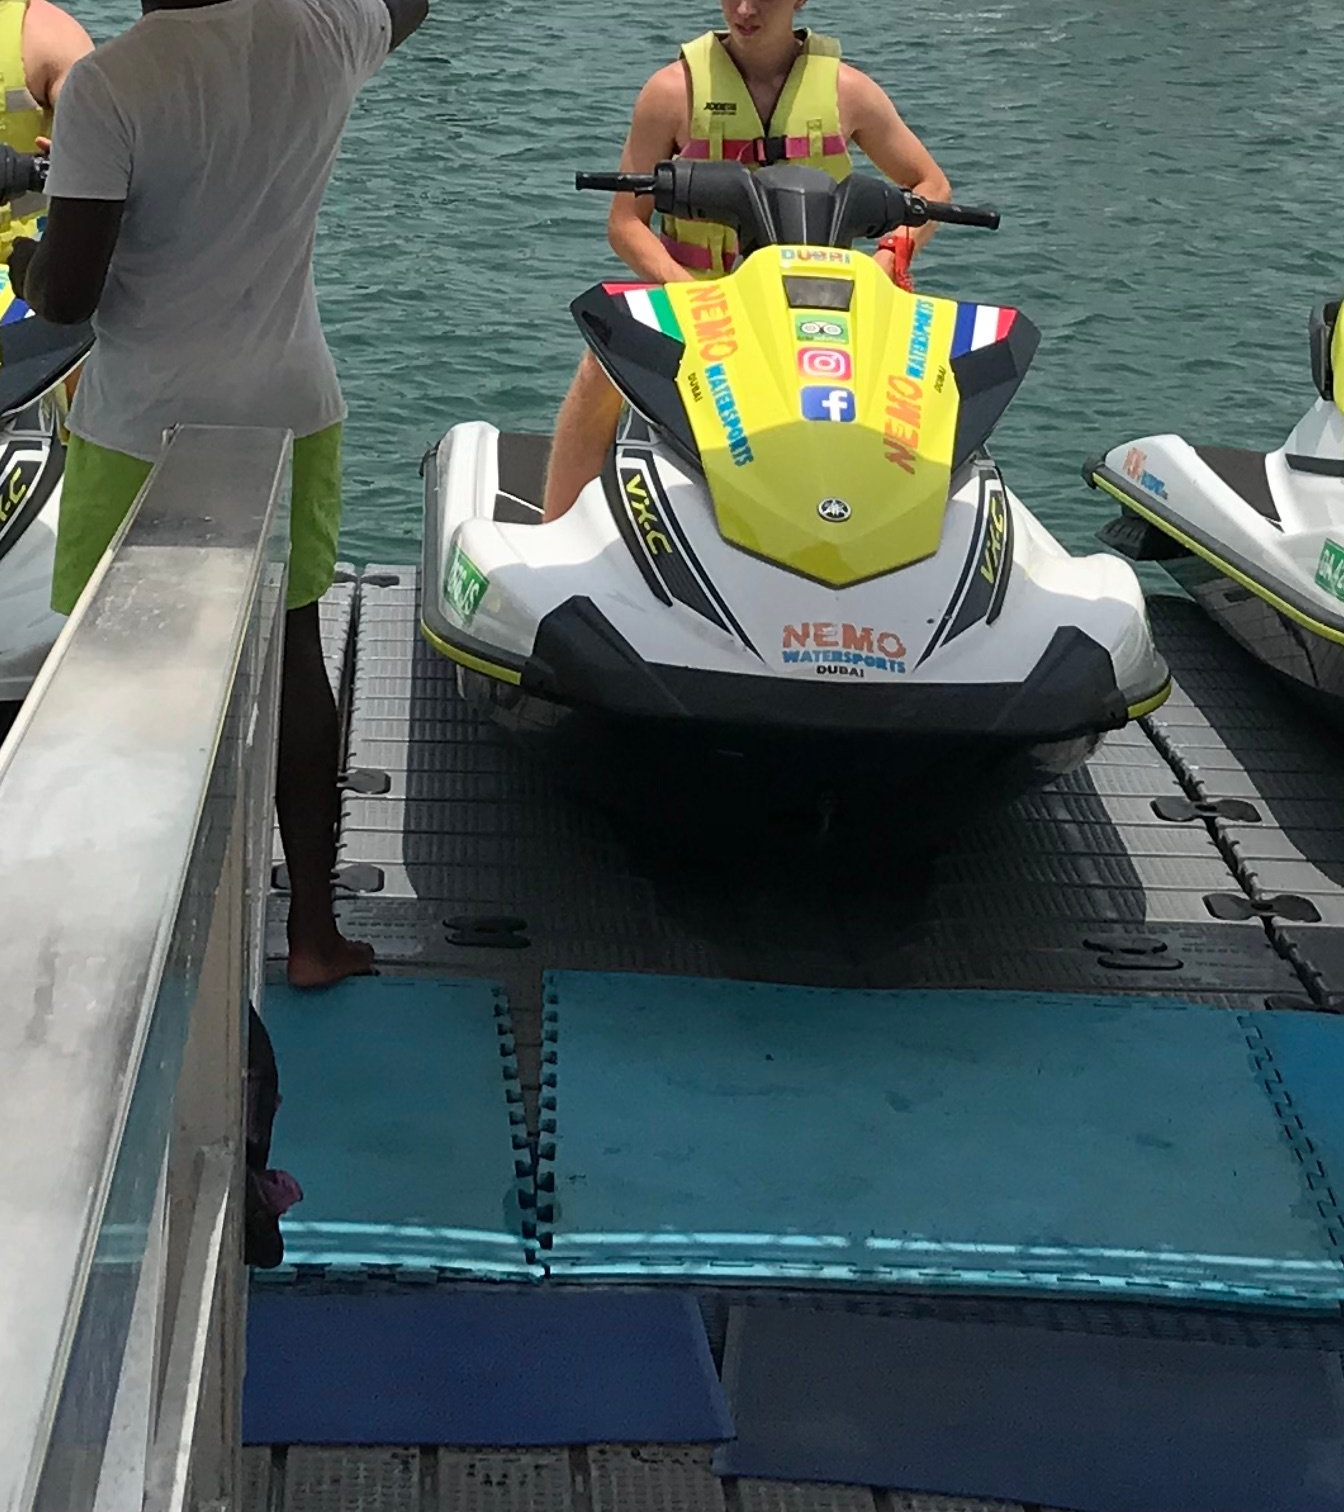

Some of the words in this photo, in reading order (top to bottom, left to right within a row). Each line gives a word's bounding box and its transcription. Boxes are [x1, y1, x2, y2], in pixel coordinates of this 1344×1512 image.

[687, 284, 738, 362] NEMO
[688, 371, 703, 403] DUBAI
[705, 362, 754, 467] WATERSPORTS
[883, 375, 923, 475] NEMO
[782, 622, 907, 658] NEMO
[782, 650, 907, 674] WATERSPORTS
[816, 665, 865, 678] DUBAI
